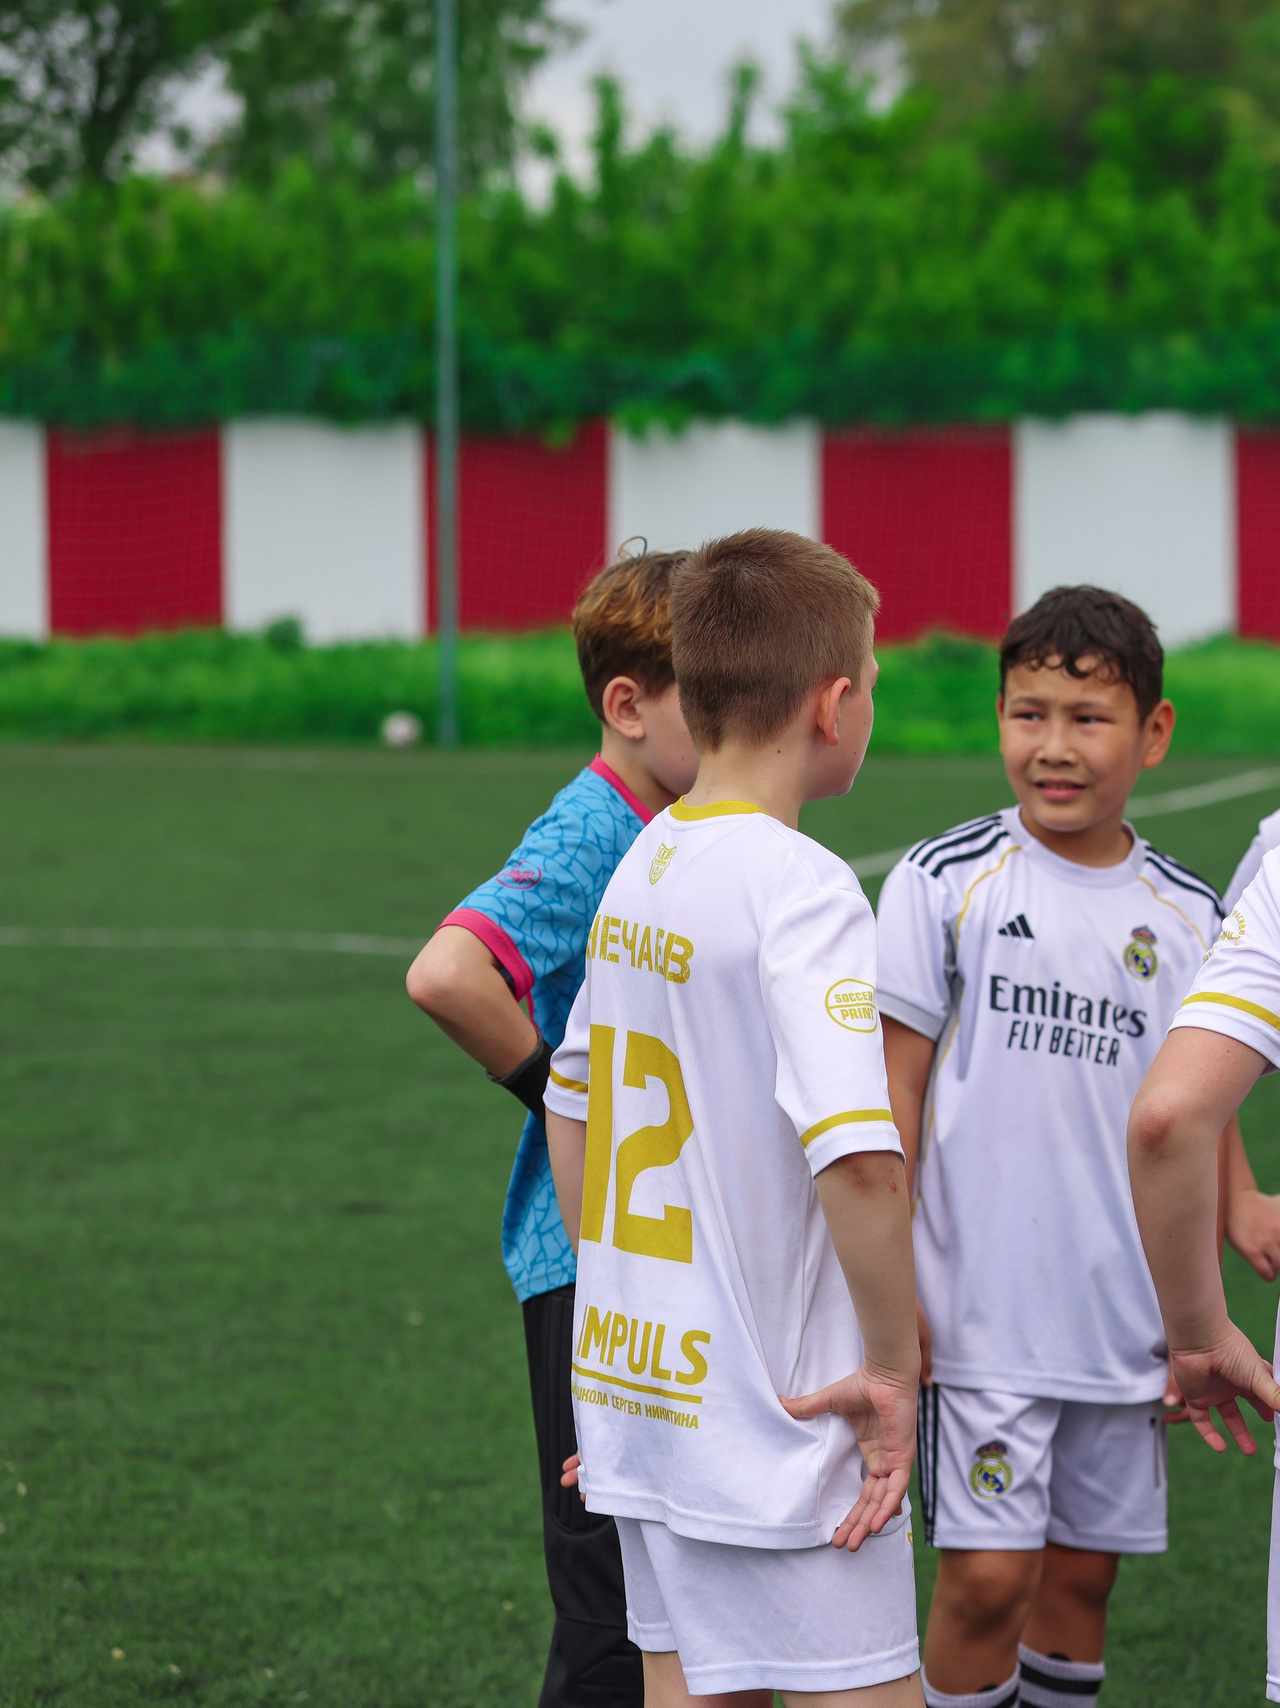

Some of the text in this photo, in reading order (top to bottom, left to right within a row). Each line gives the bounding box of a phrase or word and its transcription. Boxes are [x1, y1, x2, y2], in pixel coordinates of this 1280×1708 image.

[585, 914, 694, 984] НЕЧАЕВ
[834, 991, 873, 1003] SOCCER
[840, 1007, 873, 1020] PRINT
[990, 975, 1148, 1039] Emirates
[1007, 1020, 1044, 1051] FLY
[580, 1024, 694, 1264] 12
[611, 1395, 642, 1416] СЕРГЕЯ
[645, 1403, 699, 1429] НИКИТИНА
